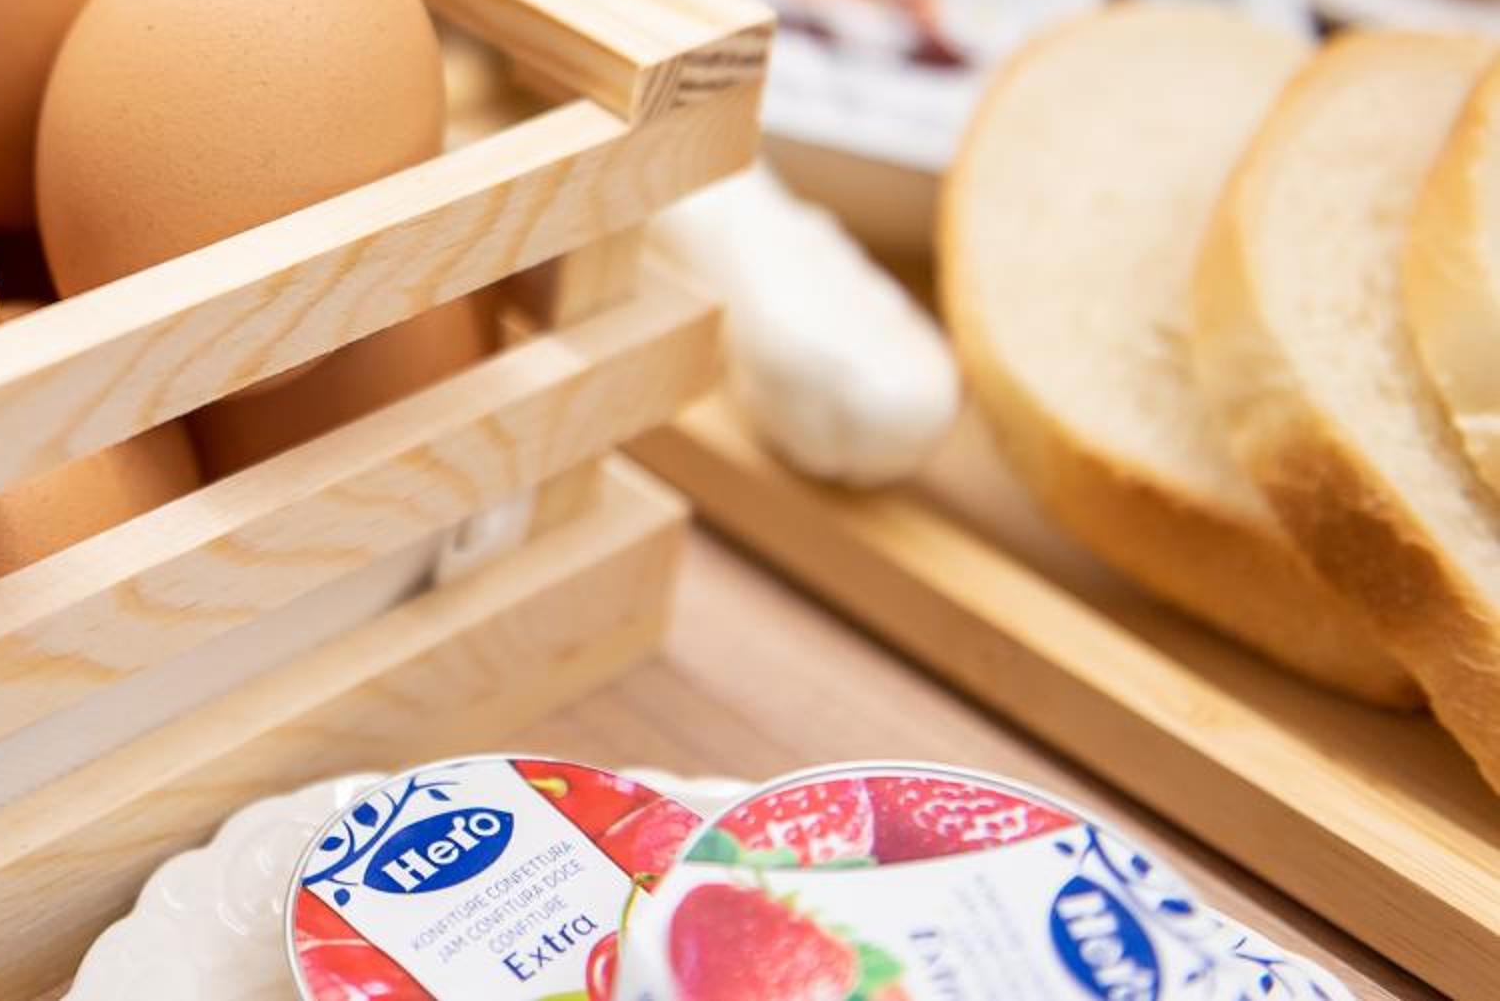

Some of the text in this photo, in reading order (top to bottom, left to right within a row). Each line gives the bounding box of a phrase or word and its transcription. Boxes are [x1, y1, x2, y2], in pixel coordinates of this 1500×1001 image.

[381, 812, 500, 892] Hero
[438, 935, 470, 964] JAM
[541, 858, 584, 889] DOCE
[488, 893, 569, 954] CONFITURE
[502, 913, 599, 983] Extra
